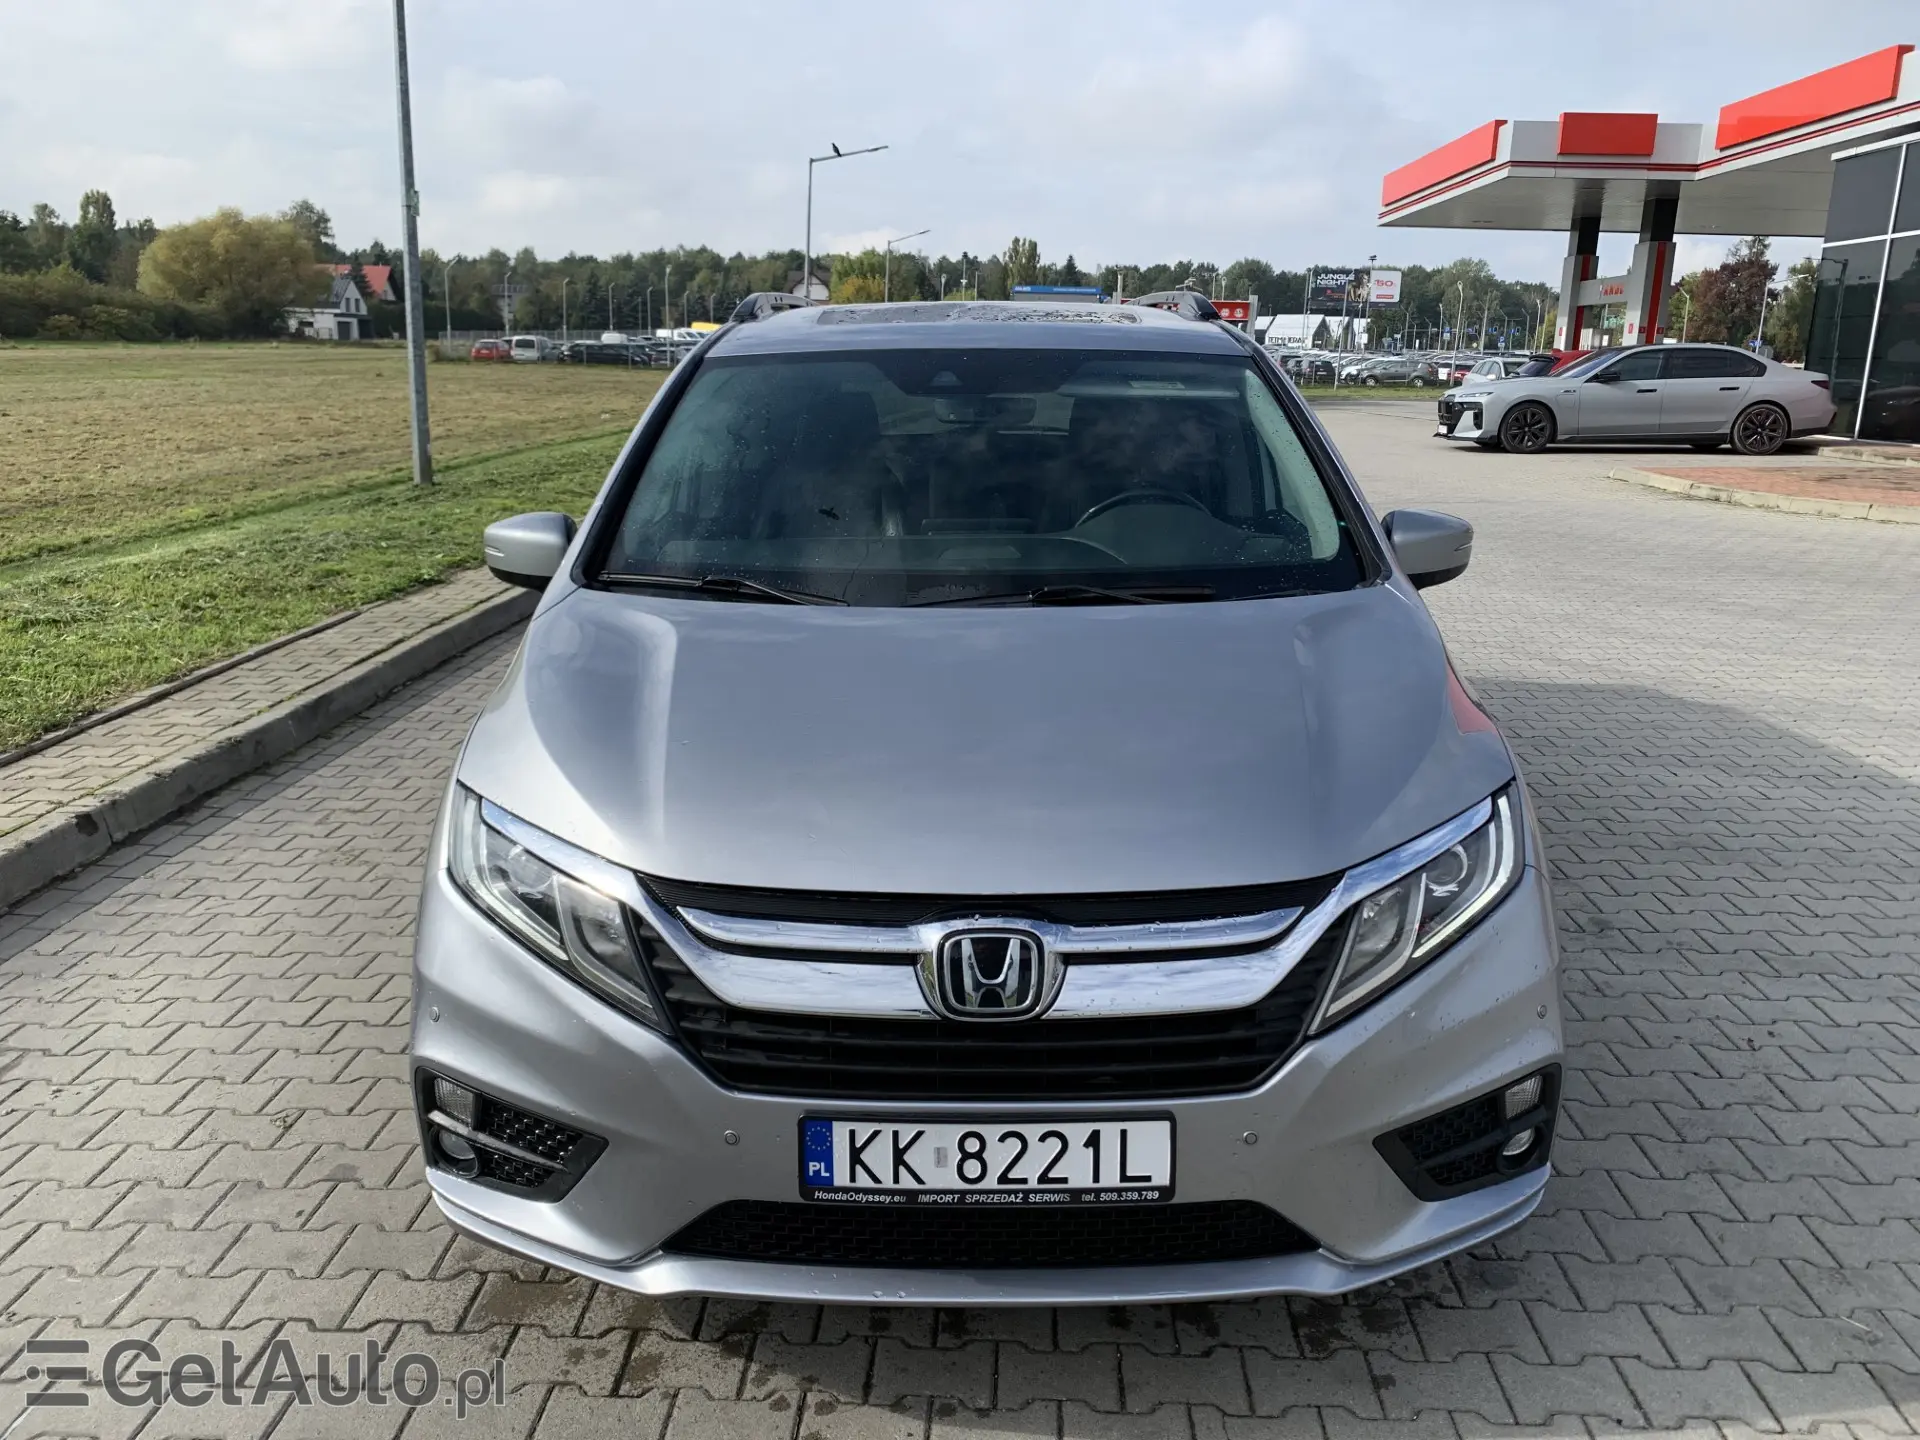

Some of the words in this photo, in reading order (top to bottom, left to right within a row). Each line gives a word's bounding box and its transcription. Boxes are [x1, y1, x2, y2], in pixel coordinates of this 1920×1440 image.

[1317, 273, 1355, 281] JUNGLE
[848, 1128, 926, 1185] KK
[955, 1129, 1152, 1185] 8221L
[808, 1162, 830, 1177] PL
[814, 1190, 906, 1203] HondaOdyssey.eu
[917, 1194, 960, 1203] IMPORT
[965, 1192, 1023, 1203] SPRZEDAŻ
[1028, 1193, 1071, 1202] SERWIS
[1081, 1193, 1096, 1202] tel.
[1099, 1191, 1159, 1201] 509.359.789
